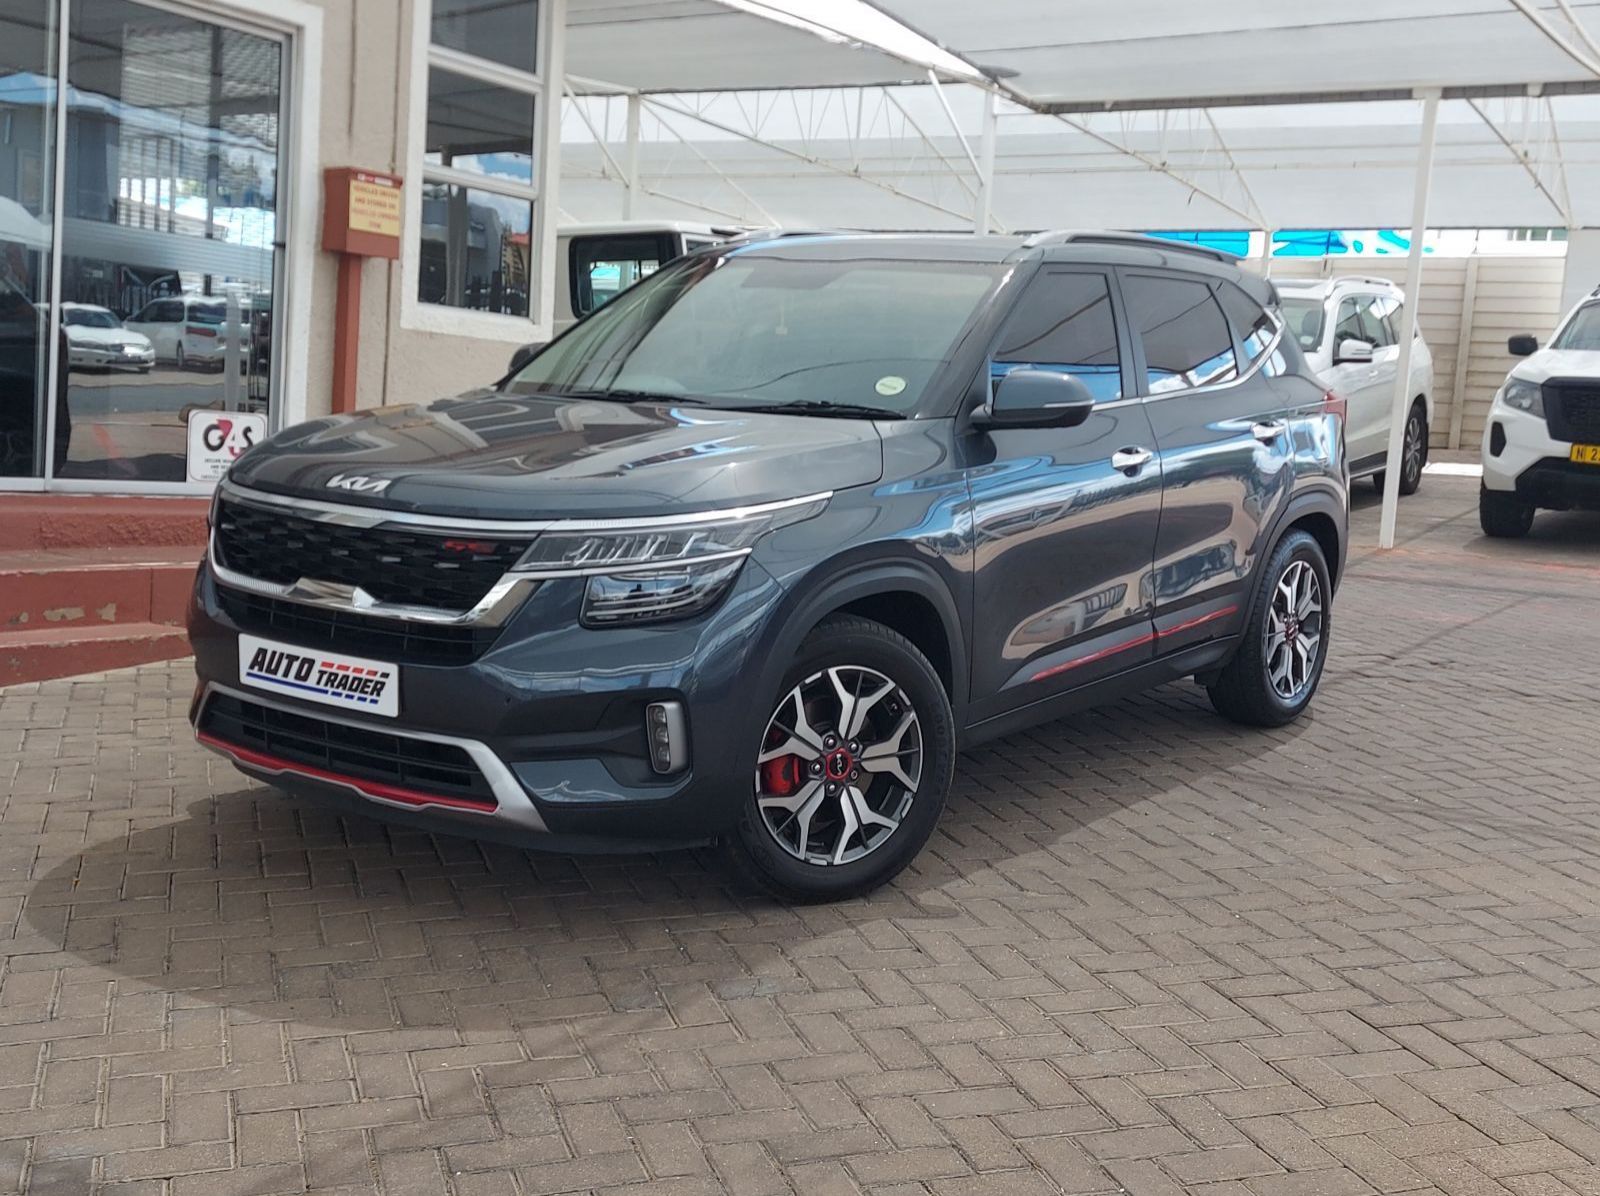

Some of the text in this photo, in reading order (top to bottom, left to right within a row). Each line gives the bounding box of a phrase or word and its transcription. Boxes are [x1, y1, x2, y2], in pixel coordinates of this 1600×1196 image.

[203, 418, 255, 458] G4S
[1576, 447, 1584, 461] N
[325, 474, 392, 493] KIA
[249, 647, 386, 698] AUTO TRADER
